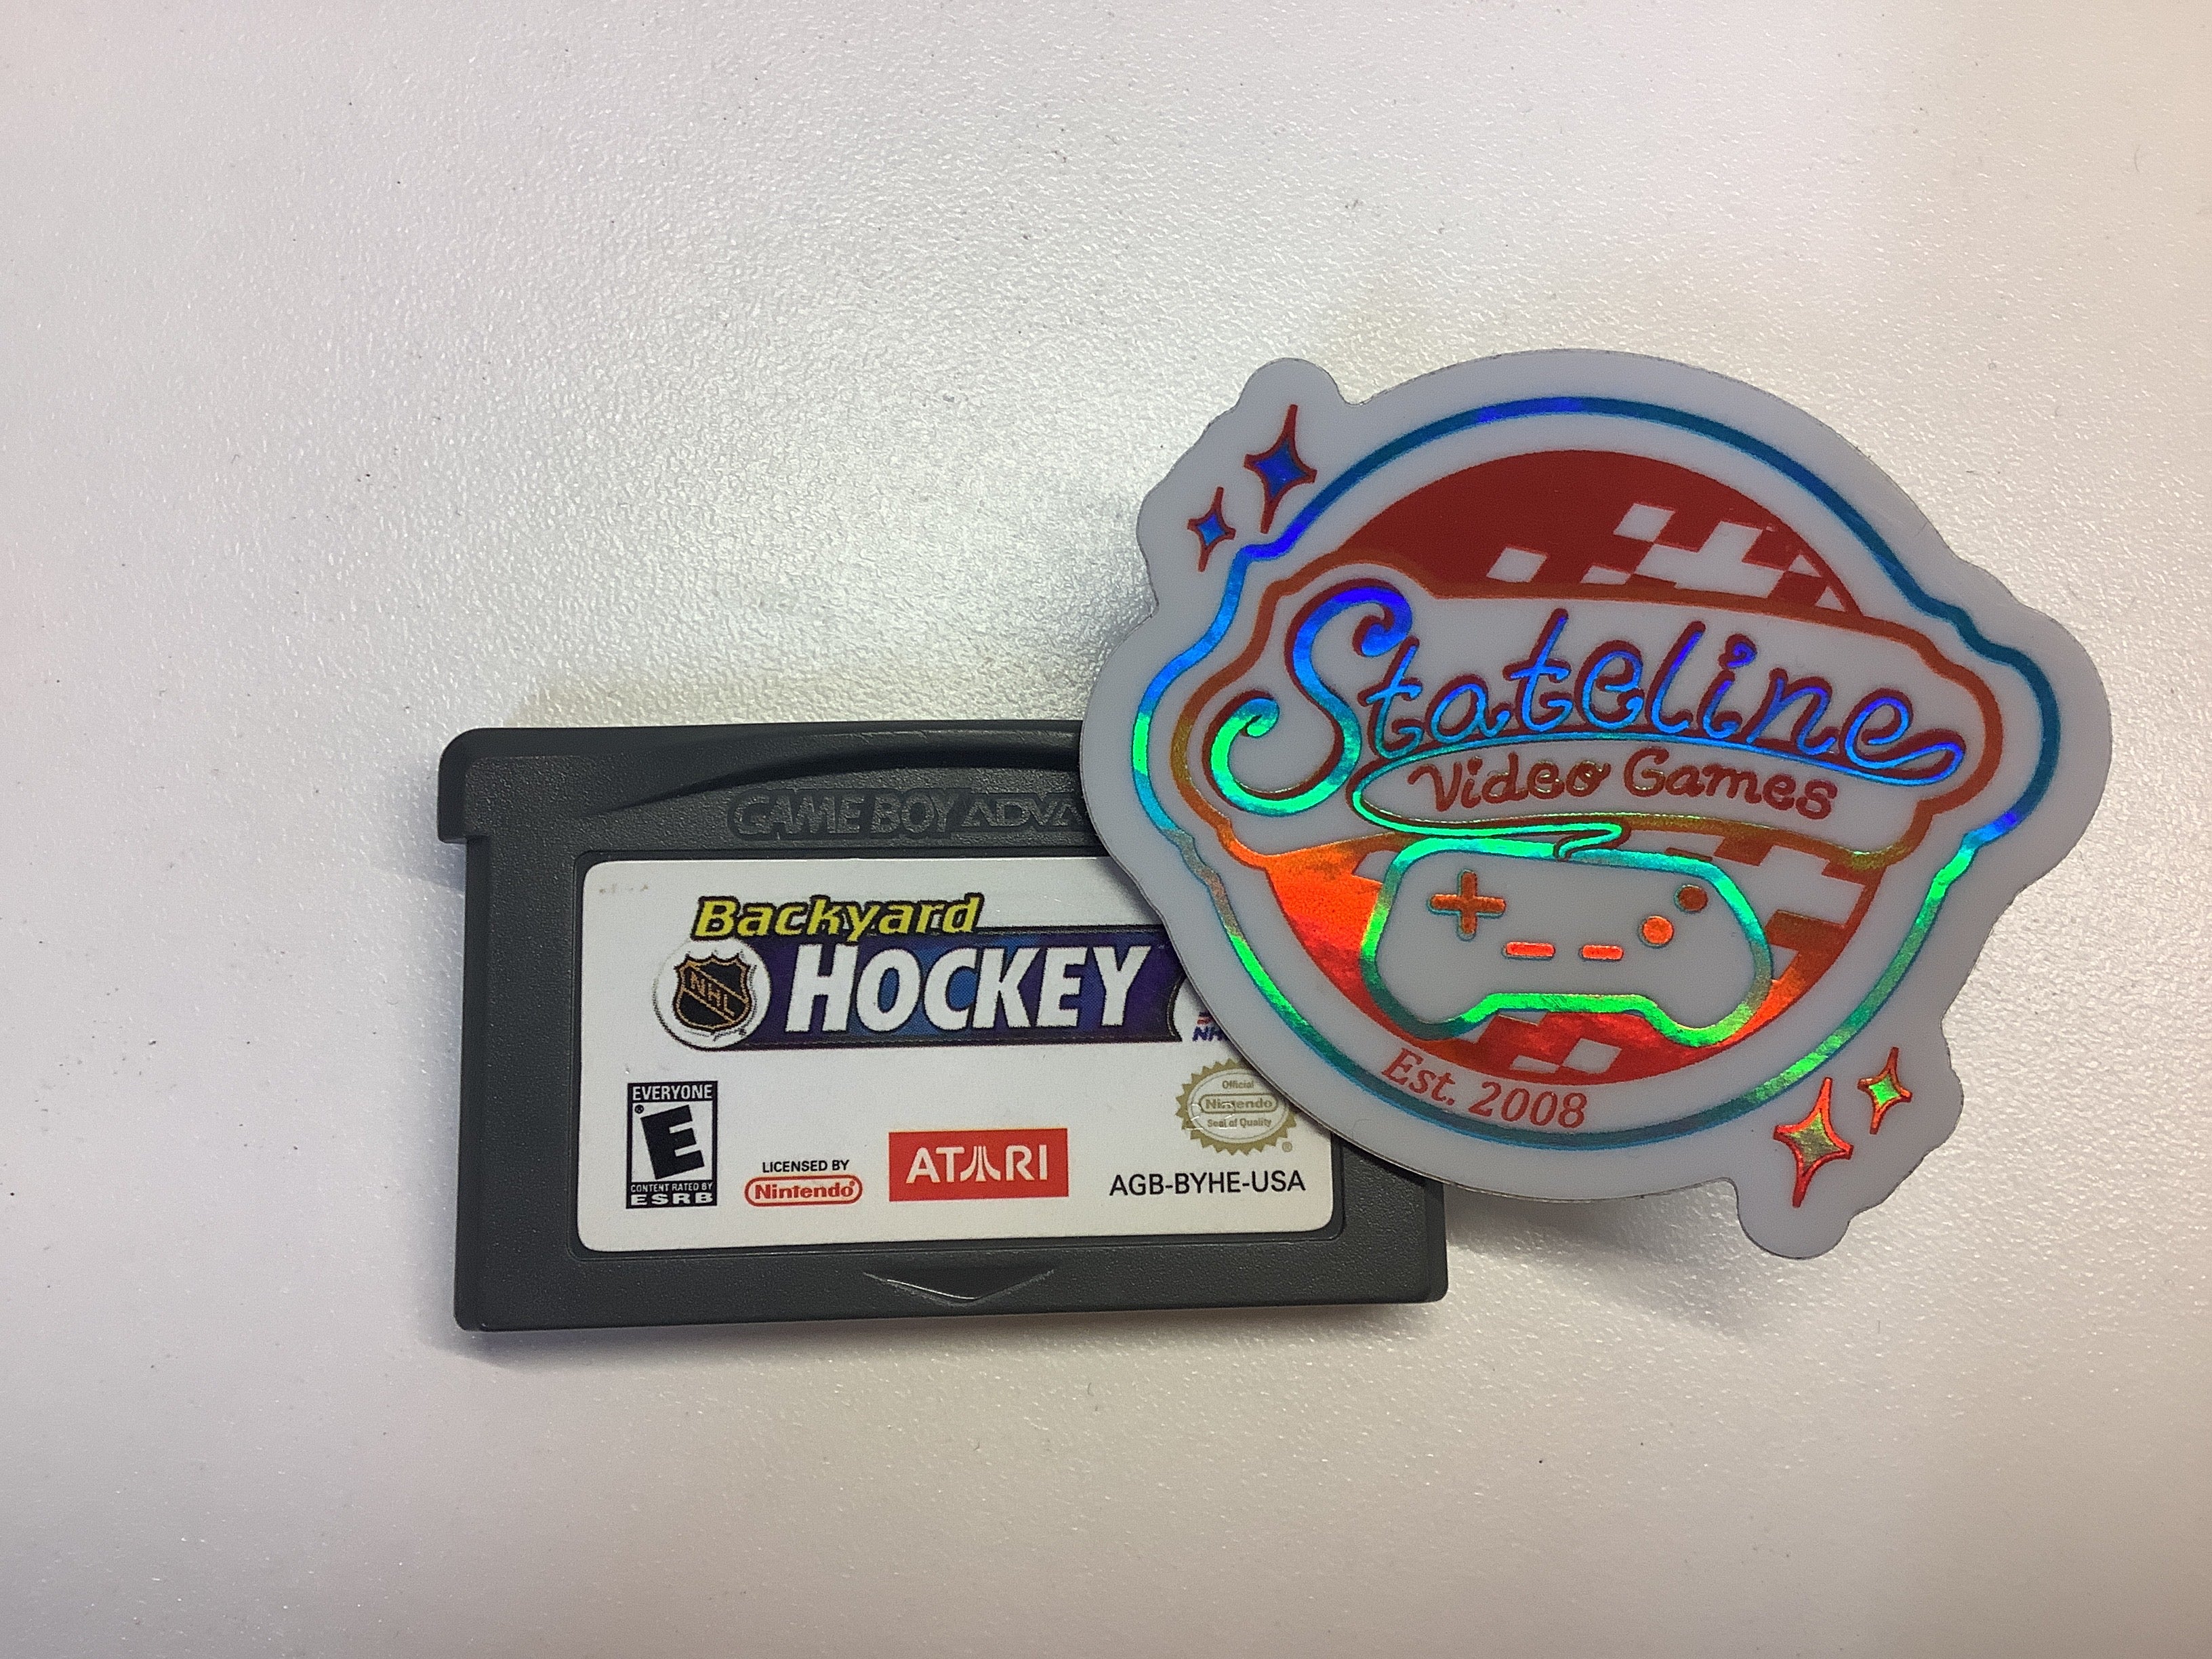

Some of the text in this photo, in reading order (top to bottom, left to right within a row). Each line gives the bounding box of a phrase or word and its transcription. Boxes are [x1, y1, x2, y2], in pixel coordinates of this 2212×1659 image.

[1204, 584, 1967, 817] Stateline
[1408, 747, 1838, 819] Video Games
[735, 791, 1083, 836] GAME BOY ADVA
[689, 893, 984, 943] Backyard
[690, 970, 736, 1018] NHL
[785, 944, 1151, 1033] HOCKEY
[632, 1084, 713, 1101] EVERYONE
[1222, 1080, 1255, 1090] Official
[1381, 1047, 1588, 1130] Est. 2008
[1204, 1097, 1273, 1111] Nintendo
[1229, 1118, 1238, 1128] of
[1240, 1118, 1272, 1128] Quality
[640, 1104, 705, 1181] E
[762, 1159, 851, 1174] LICENSED BY
[905, 1144, 1048, 1185] ATARI
[630, 1183, 714, 1193] CONTENT RATED BY
[630, 1193, 714, 1206] ESRB
[754, 1181, 857, 1200] Nintendo
[1109, 1170, 1307, 1197] AGB-BYHE-USA
